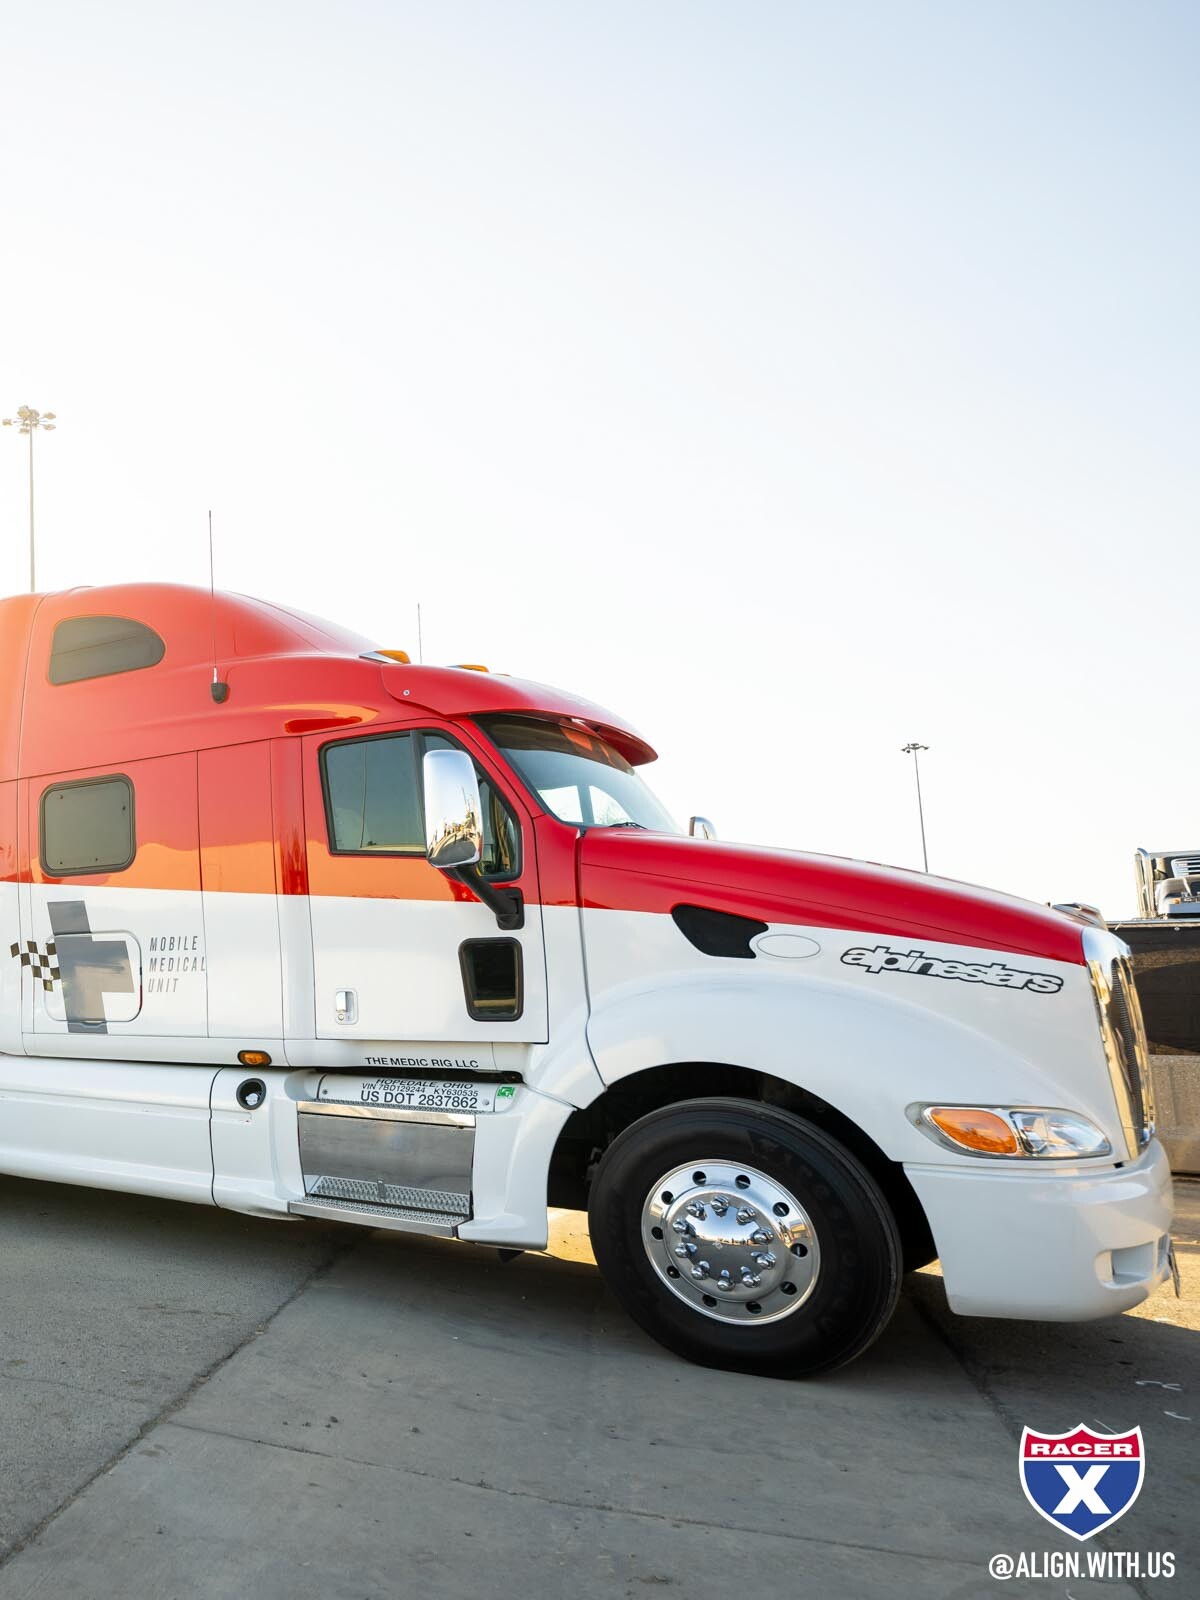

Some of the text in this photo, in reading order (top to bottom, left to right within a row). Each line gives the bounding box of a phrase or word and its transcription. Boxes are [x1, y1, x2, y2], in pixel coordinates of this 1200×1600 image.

[149, 935, 198, 952] MOBILE
[148, 956, 206, 972] MEDICAL
[840, 945, 1064, 994] alpinestars
[147, 977, 179, 993] UNIT
[365, 1056, 479, 1069] THE MEDIC RIG LLC
[362, 1082, 377, 1091] VIN
[433, 1088, 479, 1098] KY630535
[443, 1081, 473, 1090] OHIO
[360, 1090, 478, 1109] US DOT 2837862
